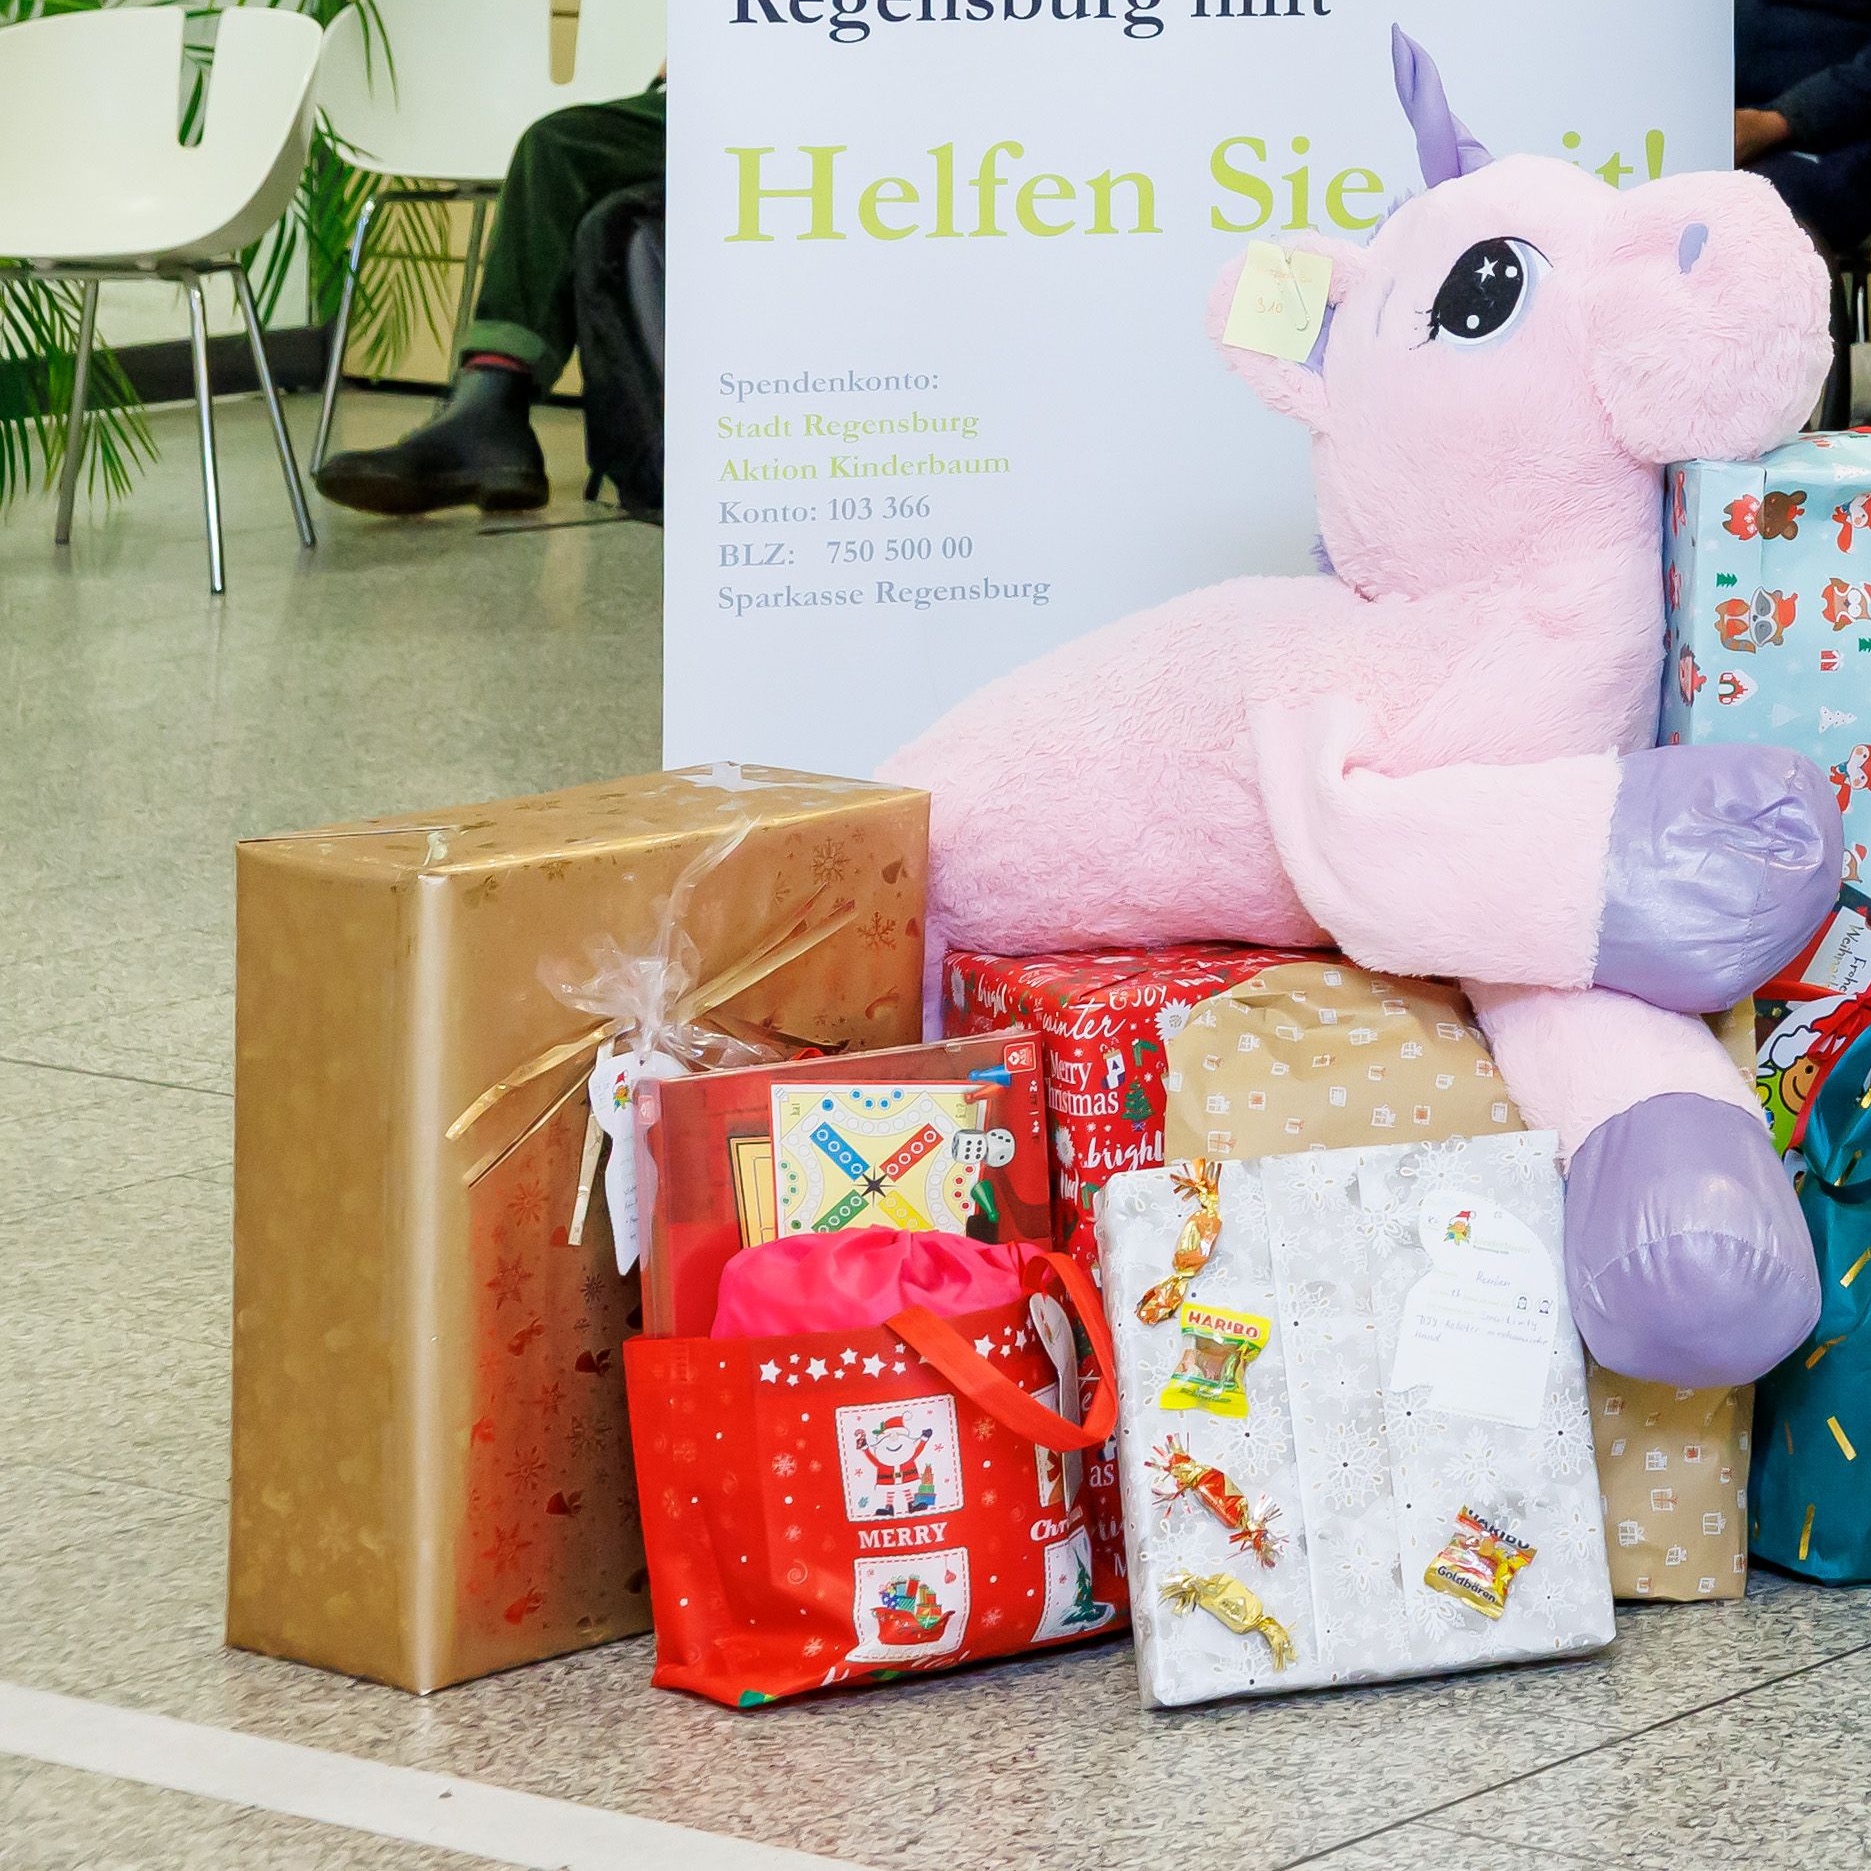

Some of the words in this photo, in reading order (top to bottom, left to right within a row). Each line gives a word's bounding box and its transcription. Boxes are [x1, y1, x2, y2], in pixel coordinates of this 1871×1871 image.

[724, 139, 1163, 243] Helfen
[1210, 136, 1385, 233] Sie
[719, 370, 939, 403] Spendenkonto:
[718, 415, 791, 439] Stadt
[804, 411, 979, 443] Regensburg
[718, 457, 817, 482] Aktion
[829, 453, 1009, 480] Kinderbaum
[718, 499, 817, 524] Konto:
[828, 498, 873, 521] 103
[882, 494, 930, 519] 366
[718, 542, 795, 567] BLZ:
[827, 540, 874, 564] 750
[885, 537, 931, 561] 500
[942, 535, 973, 559] 00
[718, 586, 863, 616] Sparkasse
[876, 576, 1051, 611] Regensburg
[1131, 985, 1167, 1007] JOY
[1042, 998, 1126, 1041] winter
[1050, 1049, 1092, 1090] Merry
[1188, 1311, 1260, 1339] HARIBO
[858, 1522, 948, 1549] MERRY
[1437, 1566, 1496, 1603] Goldbären
